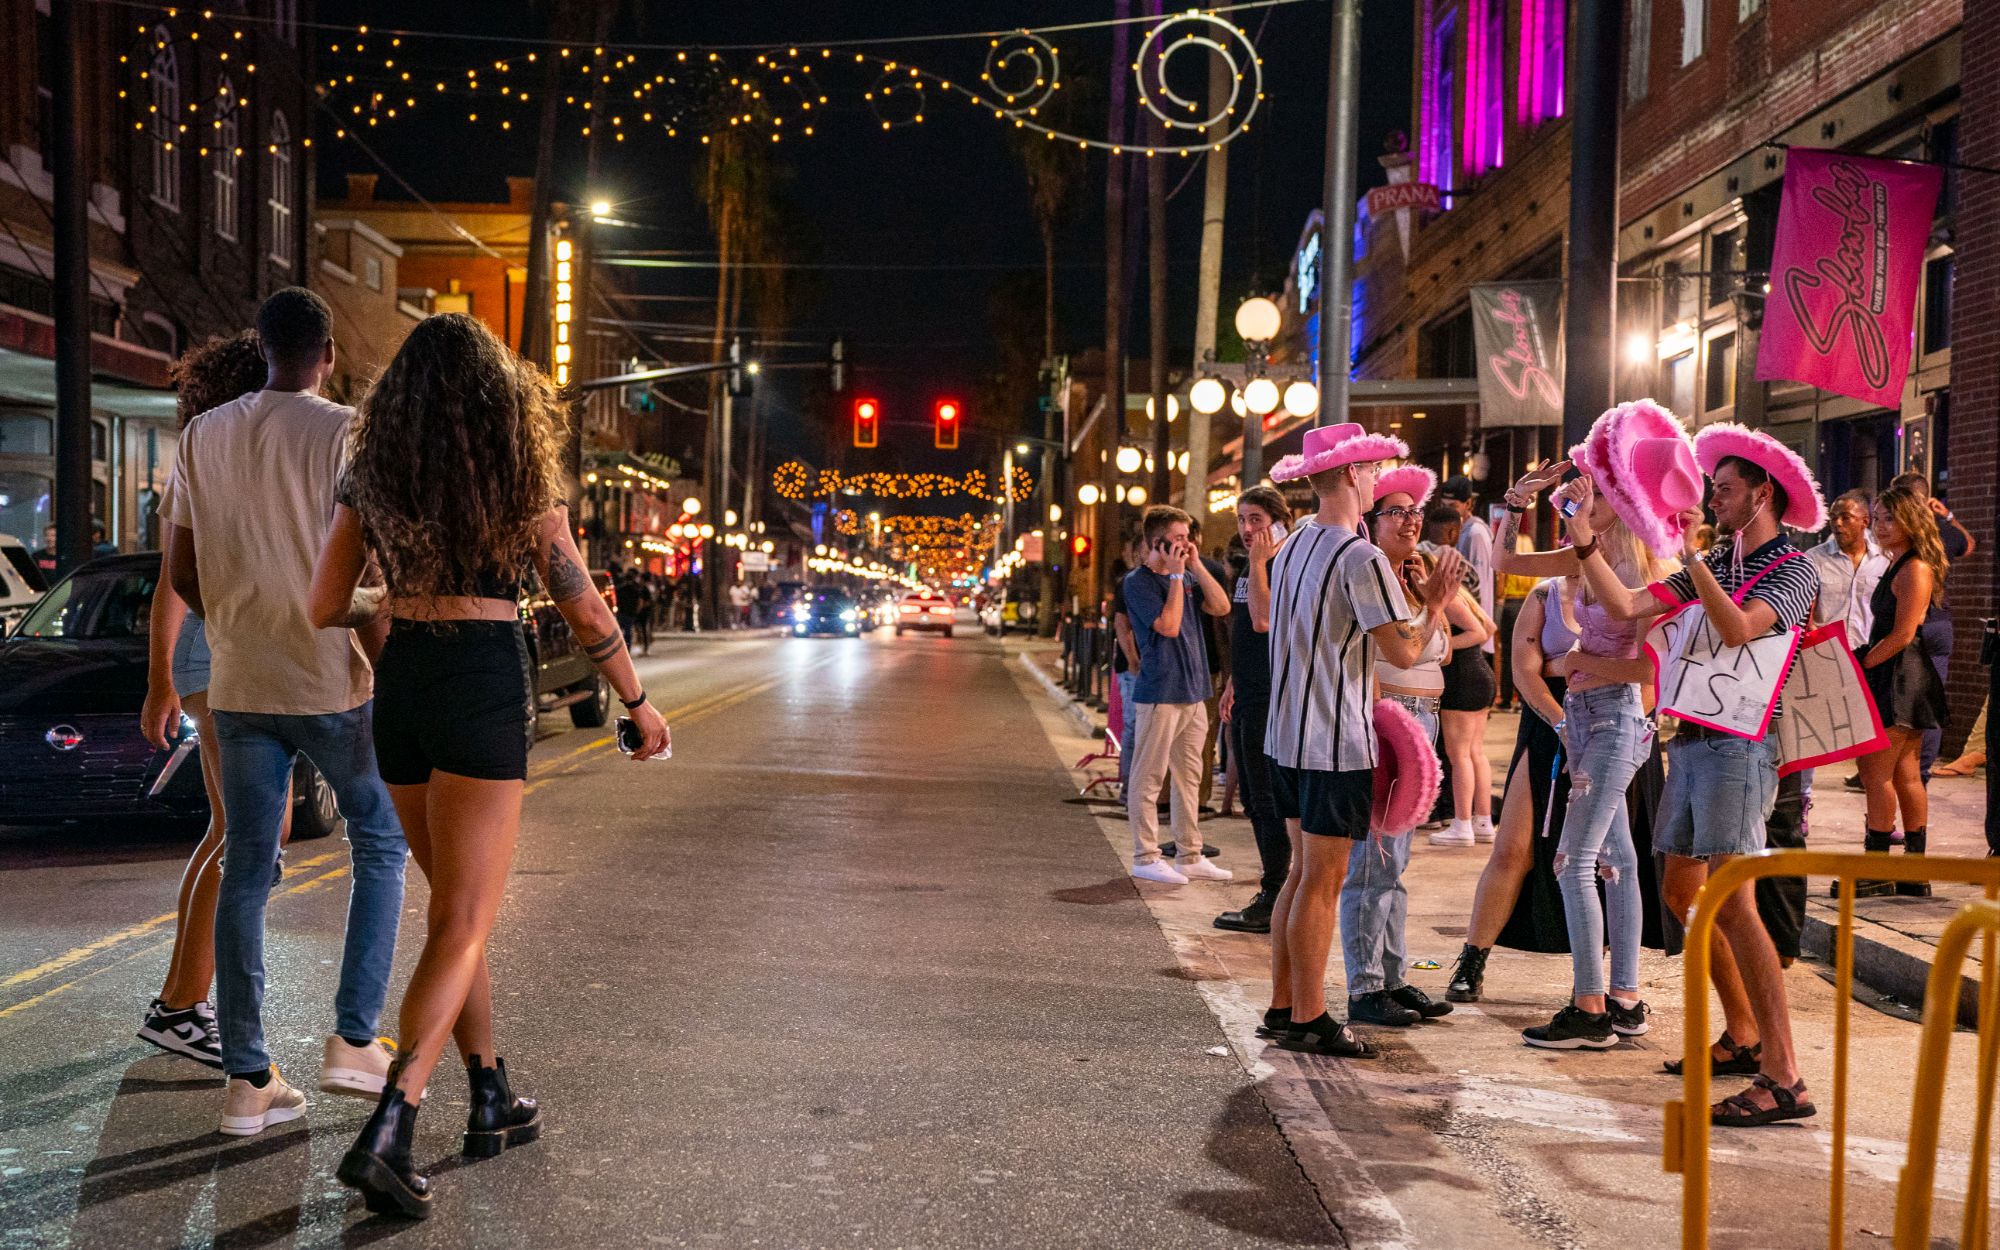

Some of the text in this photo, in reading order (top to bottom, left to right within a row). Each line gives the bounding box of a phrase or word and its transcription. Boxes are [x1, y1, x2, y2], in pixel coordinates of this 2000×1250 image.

[1373, 186, 1438, 210] PRANA
[1784, 160, 1890, 390] Showbar
[1875, 248, 1885, 275] PIANO
[1872, 276, 1884, 313] DUELING
